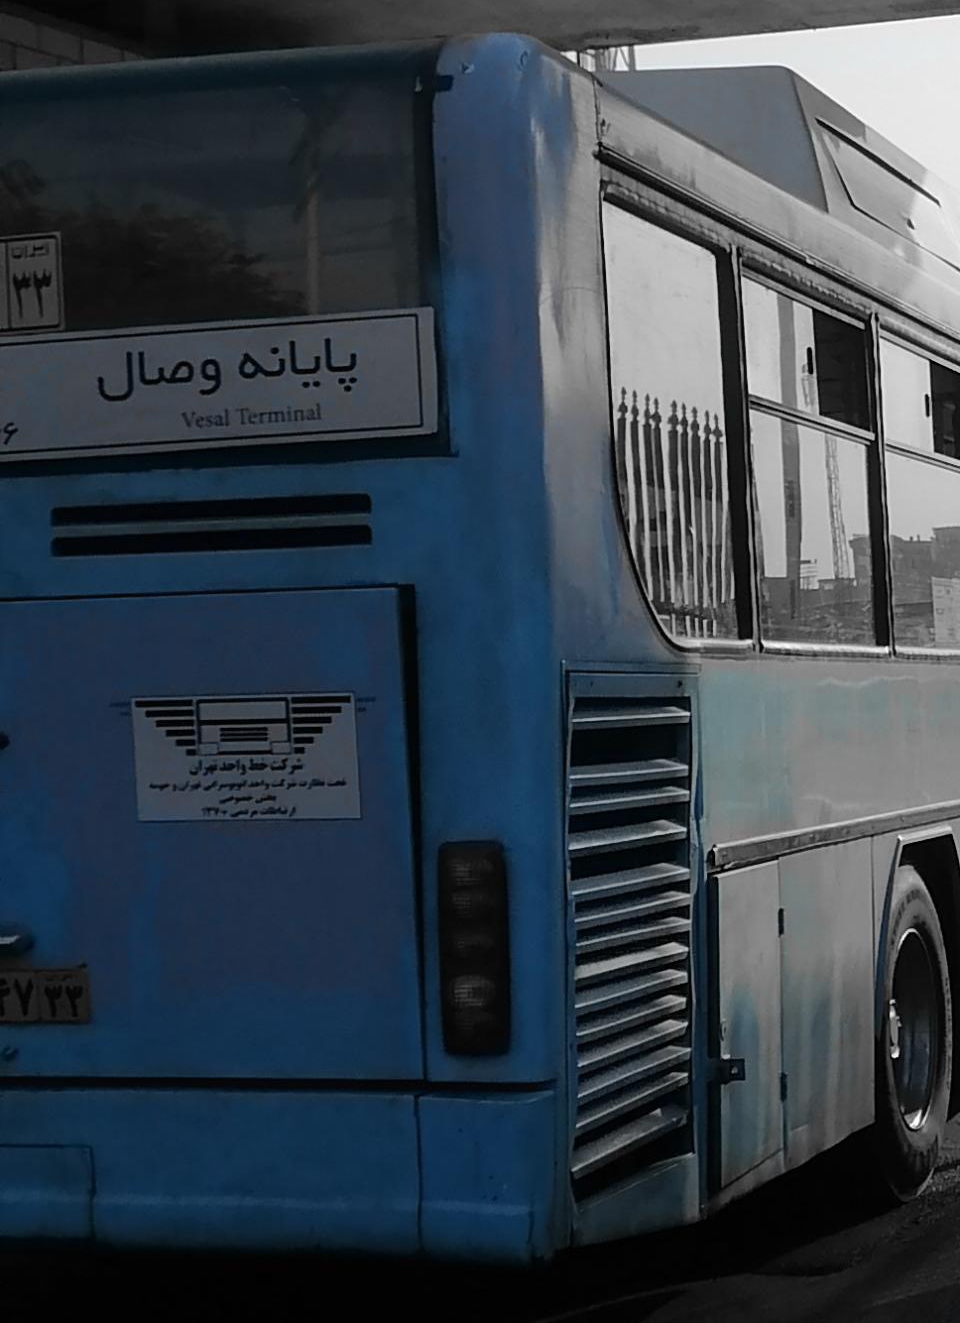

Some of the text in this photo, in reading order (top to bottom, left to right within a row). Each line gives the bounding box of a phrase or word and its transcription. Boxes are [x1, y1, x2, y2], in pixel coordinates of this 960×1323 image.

[12, 269, 53, 319] ۳۳
[97, 337, 358, 402] پایانه وصال
[181, 403, 323, 430] Vesal Terminal
[189, 757, 304, 776] شرکت خط واحد تهران
